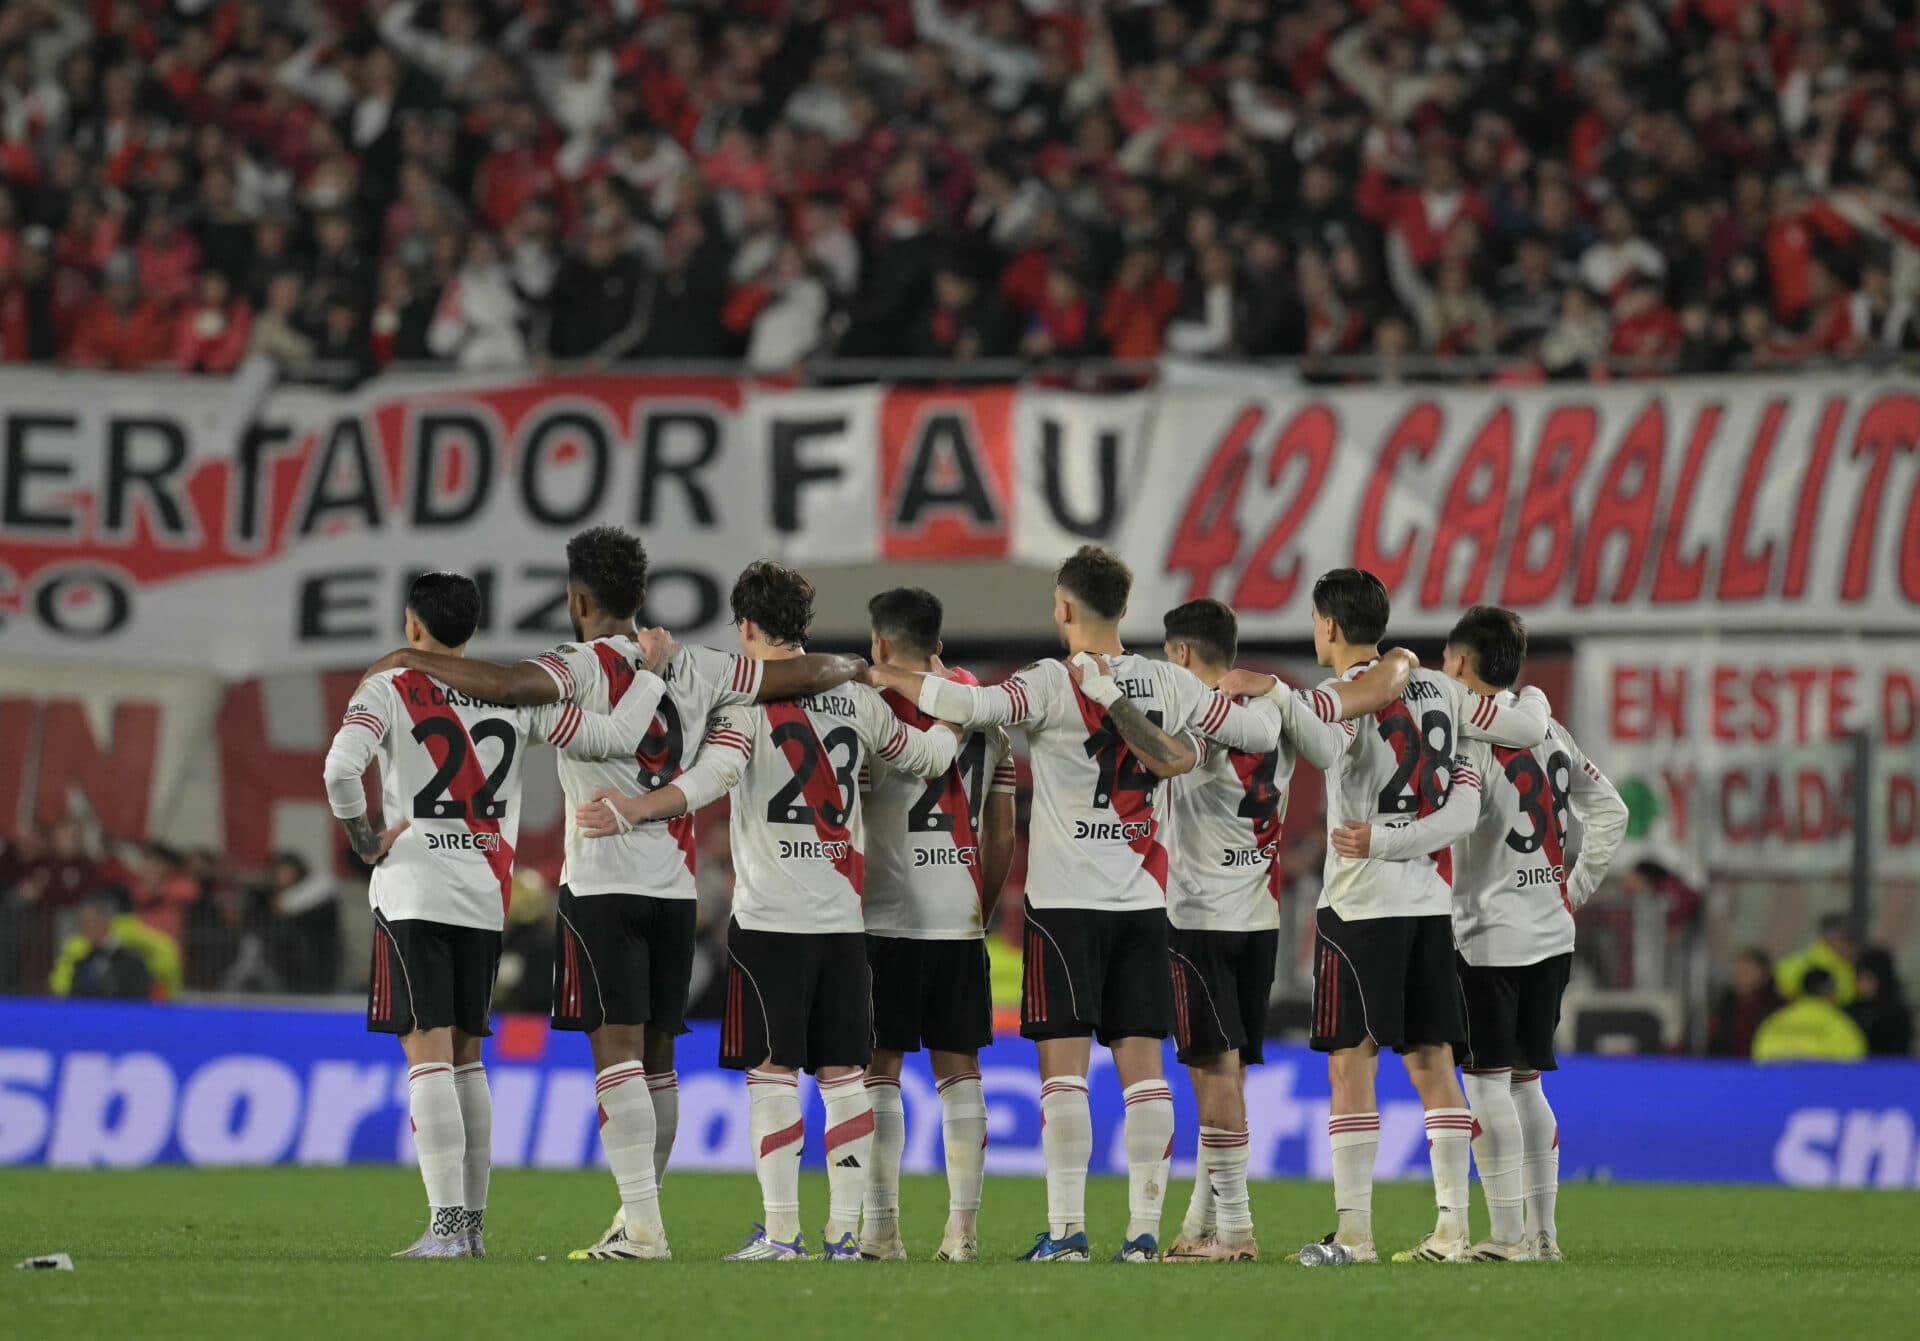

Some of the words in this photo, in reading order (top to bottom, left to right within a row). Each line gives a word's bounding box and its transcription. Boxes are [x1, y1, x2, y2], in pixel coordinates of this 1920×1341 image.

[1165, 402, 1338, 611] 42
[0, 571, 130, 641] O
[1612, 667, 1687, 742] EN
[1711, 666, 1858, 744] ESTE
[411, 716, 517, 819] 22
[767, 720, 860, 829] 23
[1378, 709, 1452, 814] 28
[1505, 750, 1572, 854] 38
[1661, 766, 1697, 843] Y
